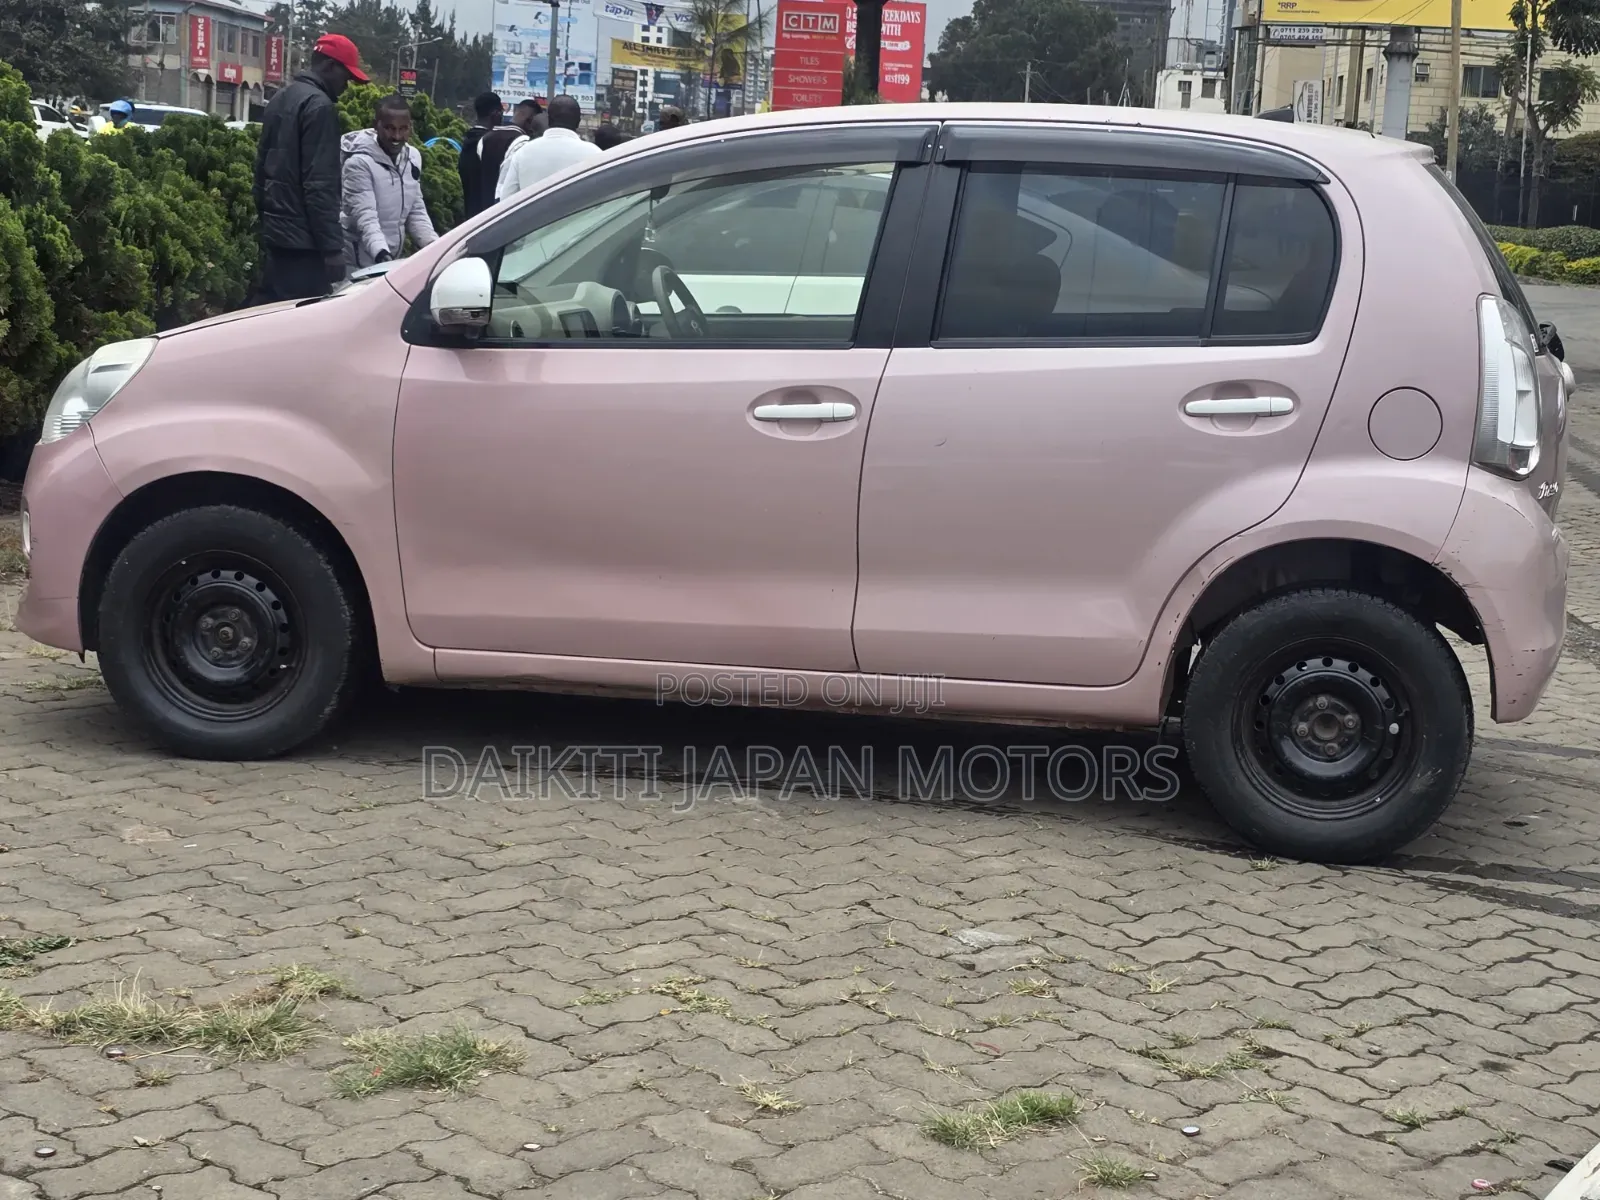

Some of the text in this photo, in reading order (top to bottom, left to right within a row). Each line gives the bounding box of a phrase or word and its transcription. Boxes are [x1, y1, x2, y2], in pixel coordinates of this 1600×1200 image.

[788, 15, 835, 30] CTM
[197, 17, 205, 56] UCHUMI
[800, 56, 820, 66] TILES
[788, 74, 828, 85] SHOWERS
[792, 93, 822, 104] TOILETS
